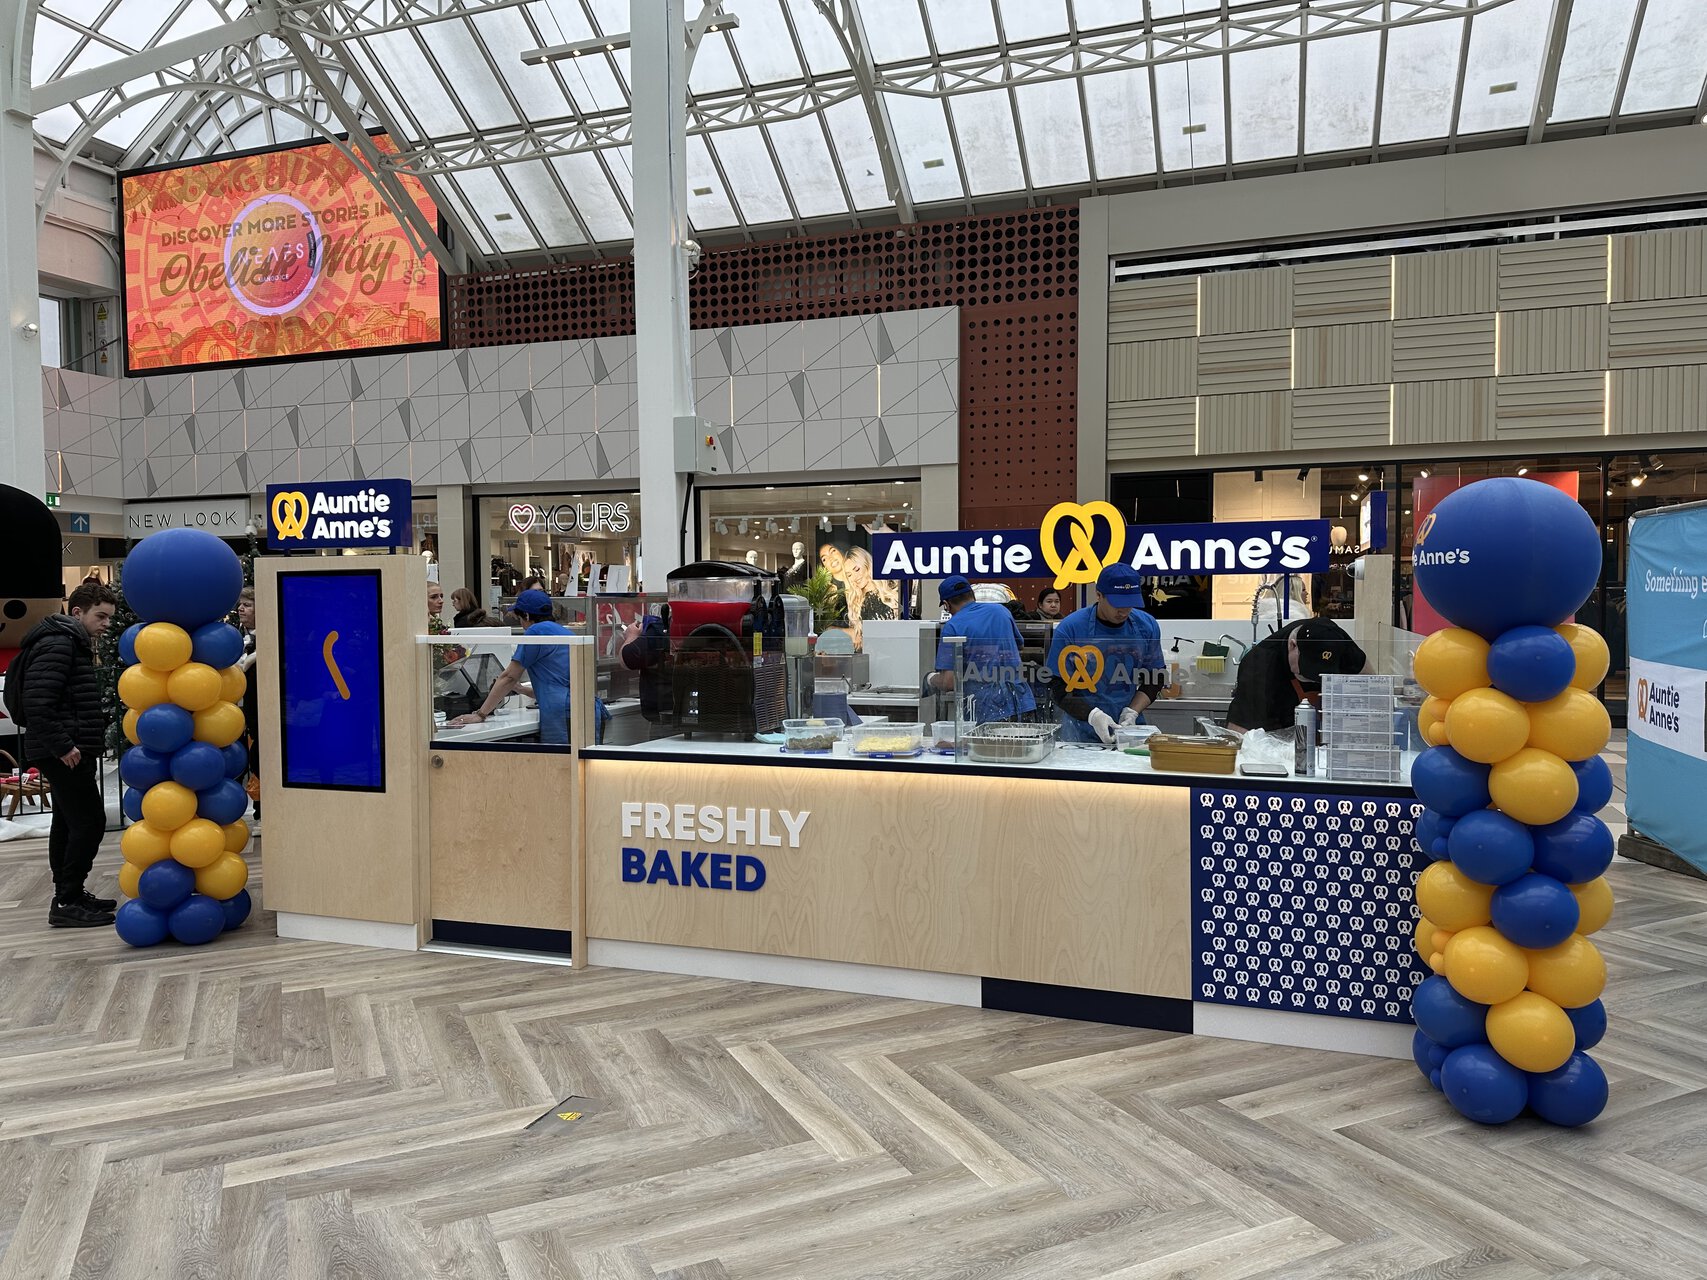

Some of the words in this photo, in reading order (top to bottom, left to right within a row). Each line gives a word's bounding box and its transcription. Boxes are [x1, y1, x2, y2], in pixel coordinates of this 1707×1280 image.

[161, 222, 243, 247] DISCOVER
[247, 214, 297, 235] MORE
[302, 203, 370, 228] STORES
[159, 243, 300, 297] Obelisk
[318, 221, 397, 296] Way
[311, 488, 391, 515] Auntie
[538, 501, 630, 533] YOURS
[129, 513, 173, 528] NEW
[183, 510, 238, 527] LOOK
[311, 516, 393, 540] Anne's
[881, 534, 1033, 575] Auntie
[1130, 530, 1311, 571] Anne's
[1419, 548, 1470, 566] Anne's
[1644, 567, 1698, 600] Something
[964, 661, 1051, 684] Auntie
[1649, 682, 1680, 709] Auntie
[1649, 706, 1680, 733] Anne's
[621, 802, 811, 848] FRESHLY
[621, 847, 767, 892] BAKED
